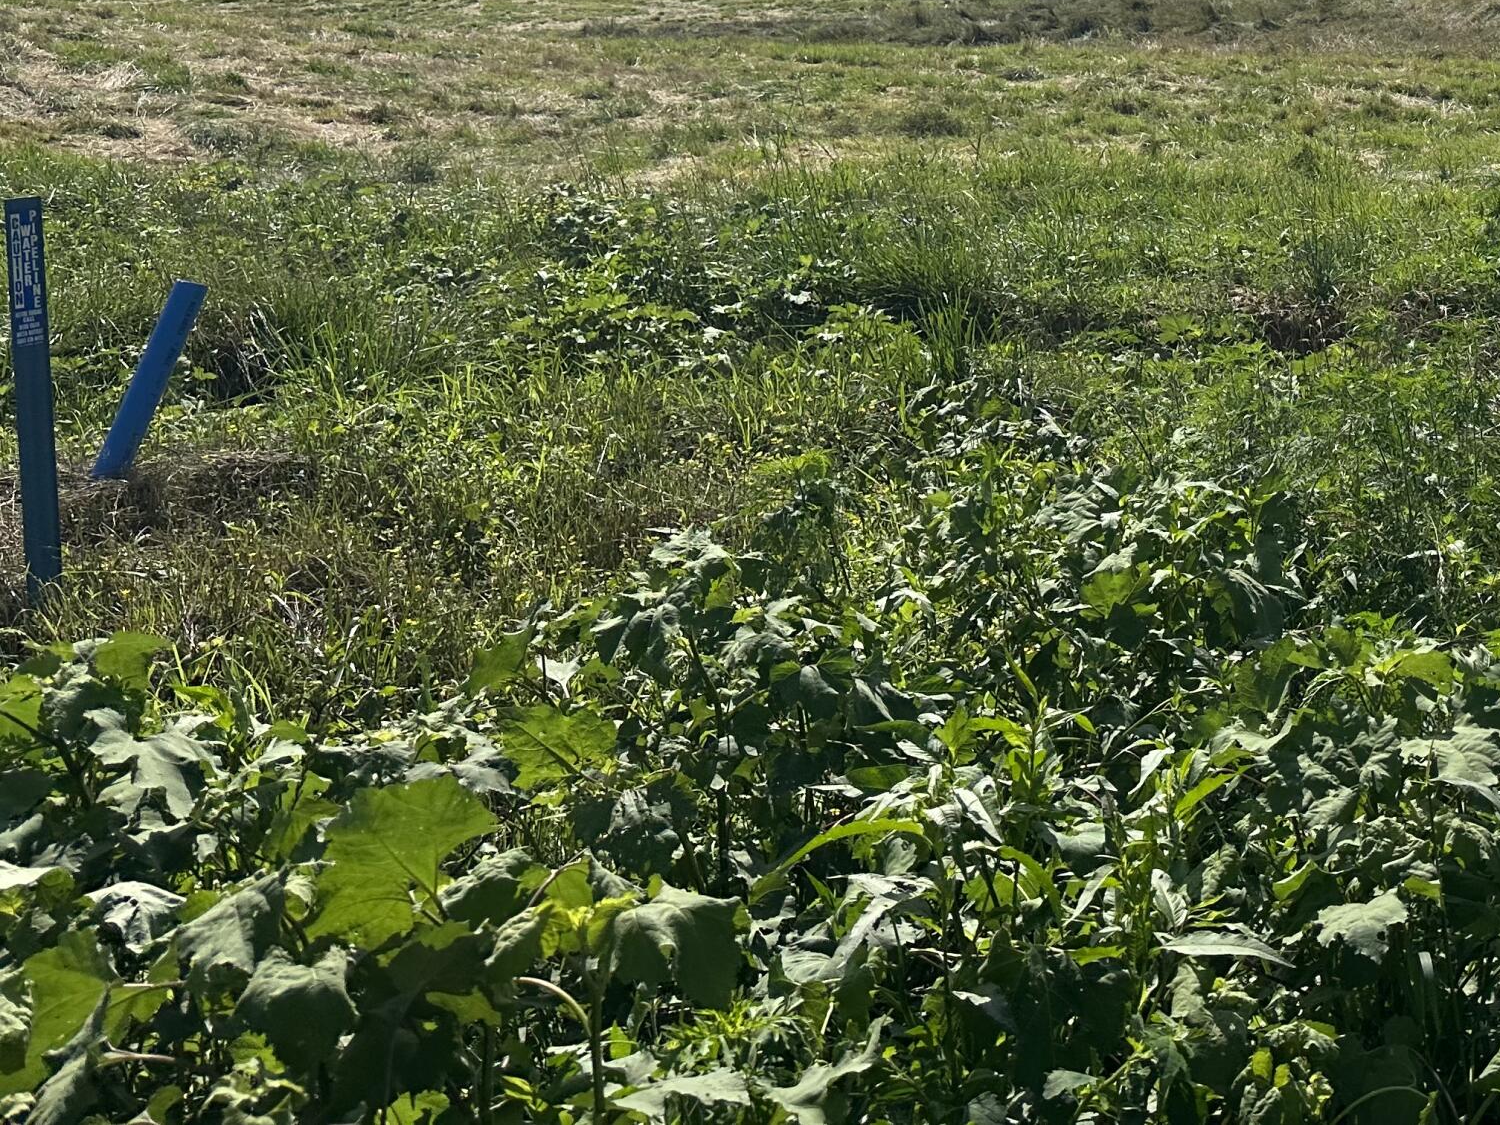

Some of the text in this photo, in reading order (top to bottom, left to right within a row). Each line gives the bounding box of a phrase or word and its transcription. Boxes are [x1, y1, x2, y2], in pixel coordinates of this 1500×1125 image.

[11, 216, 24, 307] CAUTION
[20, 225, 32, 287] WATER
[29, 210, 41, 308] PIPELINE
